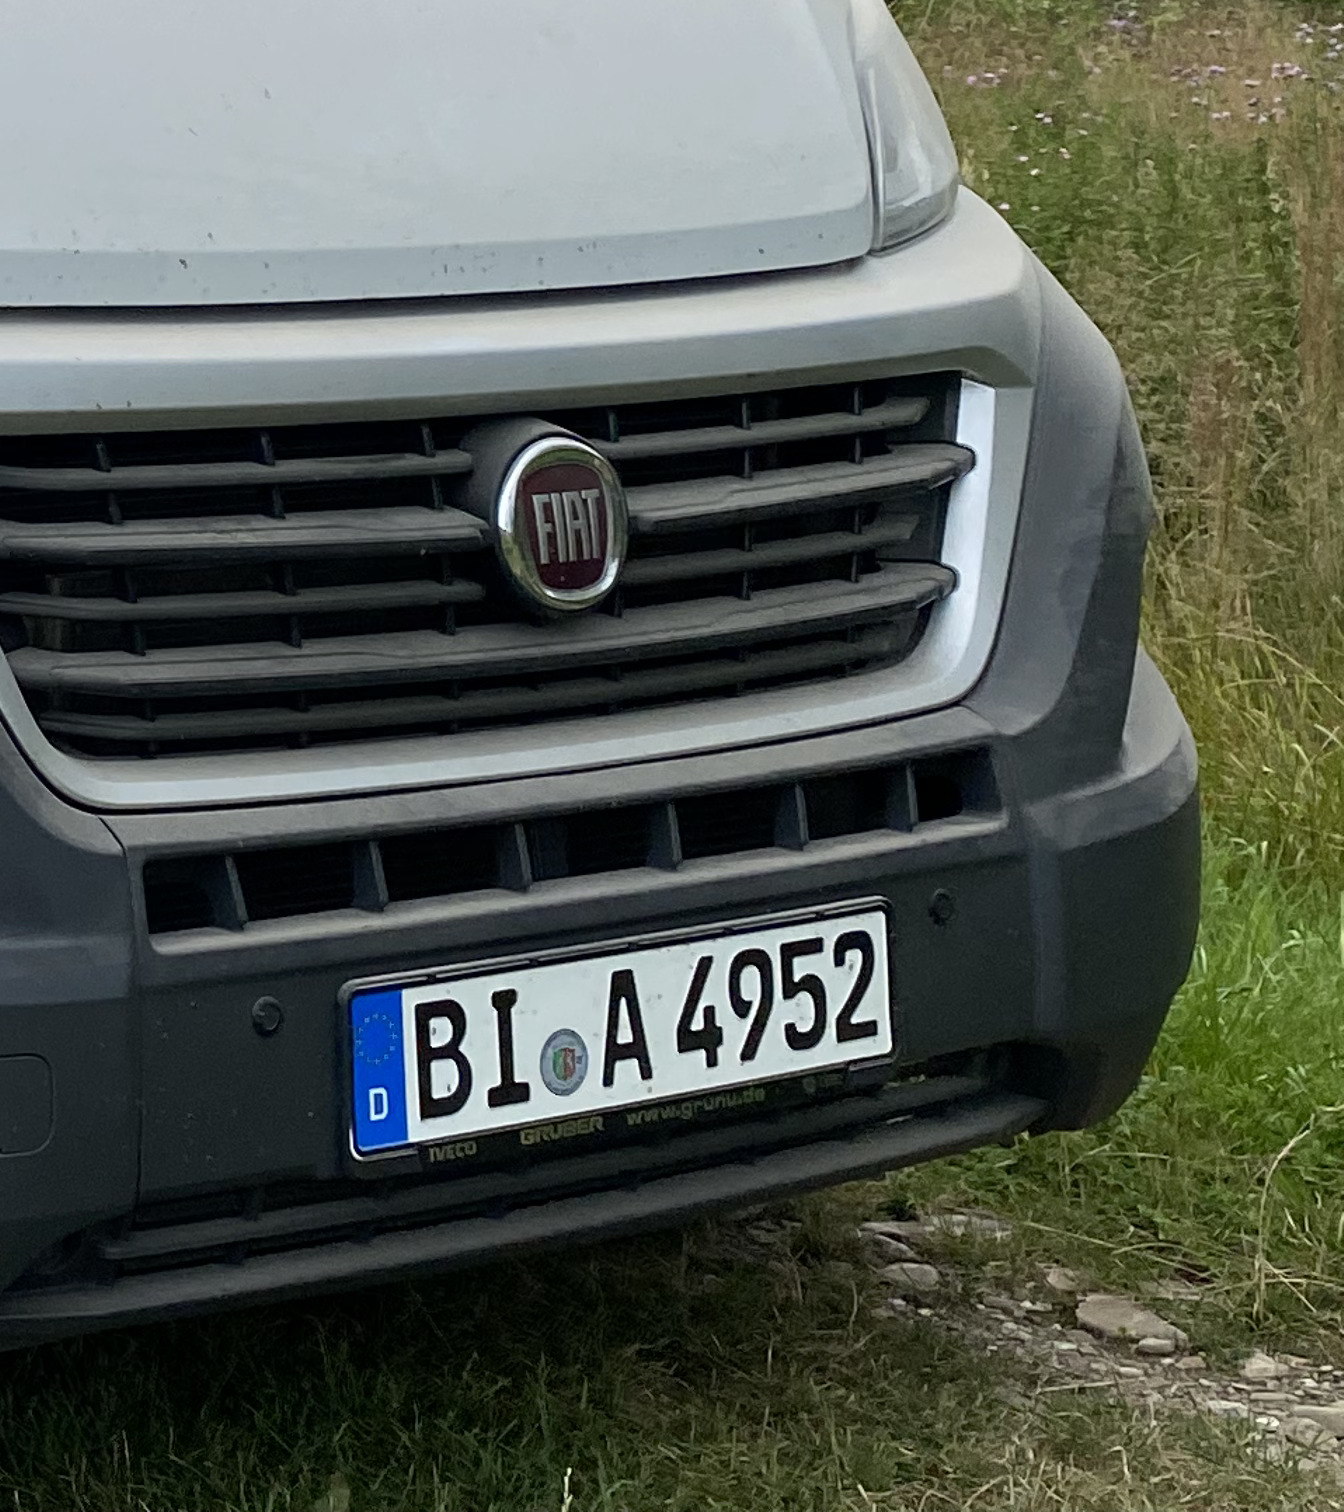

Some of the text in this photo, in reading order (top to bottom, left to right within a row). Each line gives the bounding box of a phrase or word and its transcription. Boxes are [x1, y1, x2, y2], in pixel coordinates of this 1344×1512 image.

[531, 488, 601, 565] FIAT
[414, 988, 531, 1120] BI
[602, 969, 653, 1088] A
[676, 930, 878, 1069] 4952
[368, 1087, 389, 1122] D
[428, 1140, 478, 1163] IVECO
[519, 1116, 605, 1145] GRUBER
